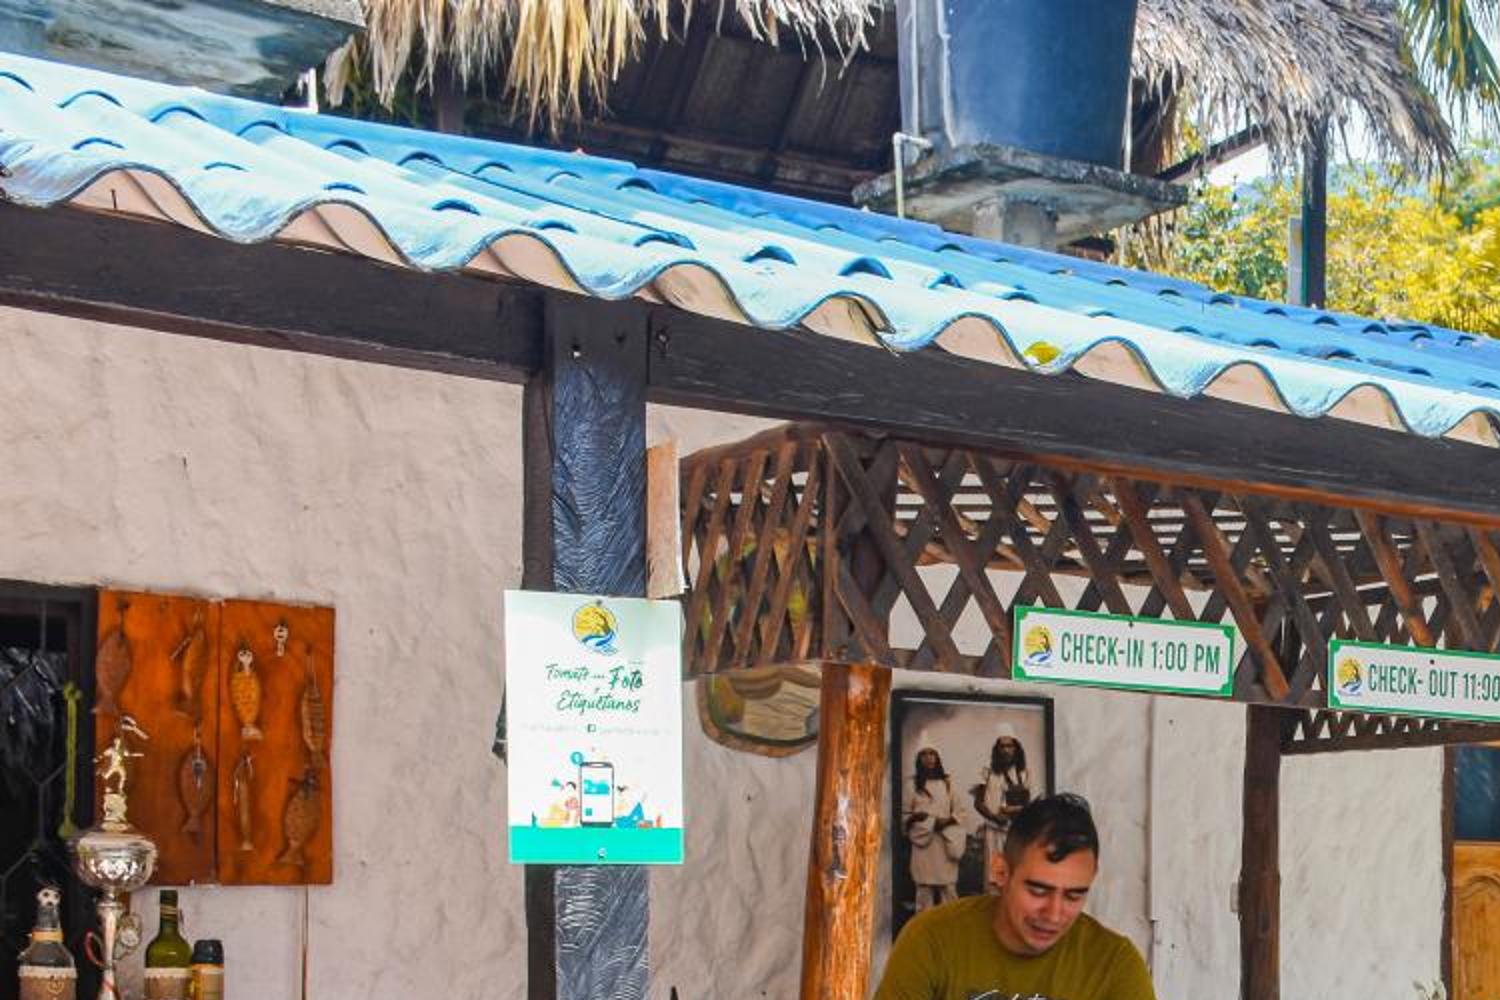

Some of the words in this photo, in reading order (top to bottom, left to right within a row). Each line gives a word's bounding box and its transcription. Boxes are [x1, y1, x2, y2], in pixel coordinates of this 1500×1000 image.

[1060, 631, 1144, 668] CHECK-IN
[1151, 641, 1187, 672] 1:00
[1194, 643, 1221, 674] PM
[608, 665, 643, 691] Foto
[1369, 663, 1423, 694] CHECK-
[1429, 669, 1458, 698] OUT
